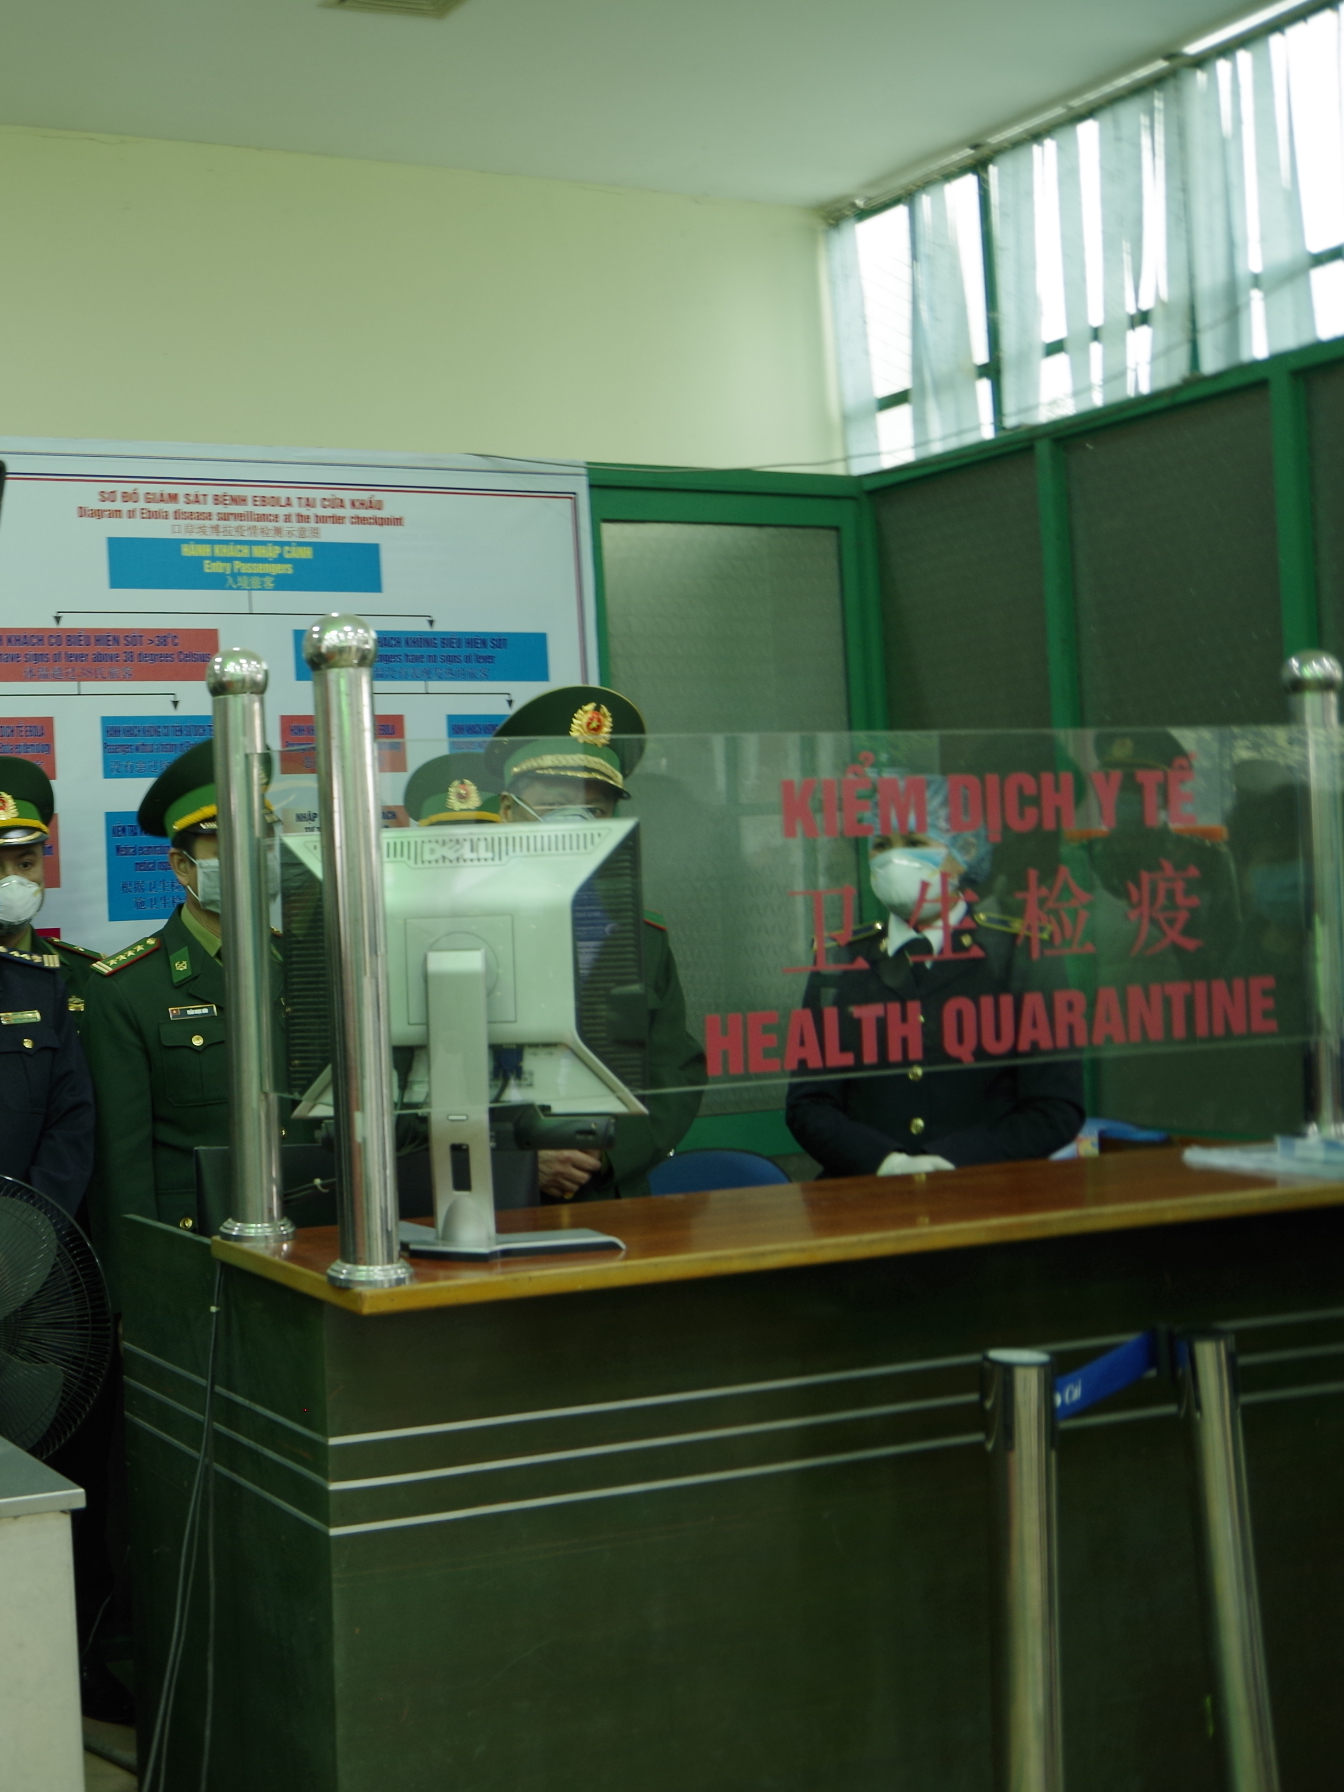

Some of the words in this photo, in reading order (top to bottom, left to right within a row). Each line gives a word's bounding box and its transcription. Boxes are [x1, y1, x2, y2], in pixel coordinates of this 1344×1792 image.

[77, 506, 122, 520] Diagram
[126, 508, 136, 519] of
[140, 507, 169, 520] Ebola
[173, 508, 212, 521] disease
[283, 513, 293, 523] at
[296, 512, 311, 524] the
[203, 559, 231, 574] Entry
[233, 561, 294, 574] Passengers
[24, 651, 50, 664] signs
[52, 651, 62, 663] of
[780, 751, 928, 839] KIỂM
[947, 771, 1075, 843] DỊCH
[1089, 770, 1123, 828] Y
[421, 840, 495, 861] DELL
[782, 859, 1205, 975] 卫生检疫
[705, 1001, 924, 1077] HEALTH
[942, 975, 1279, 1064] QUARANTINE
